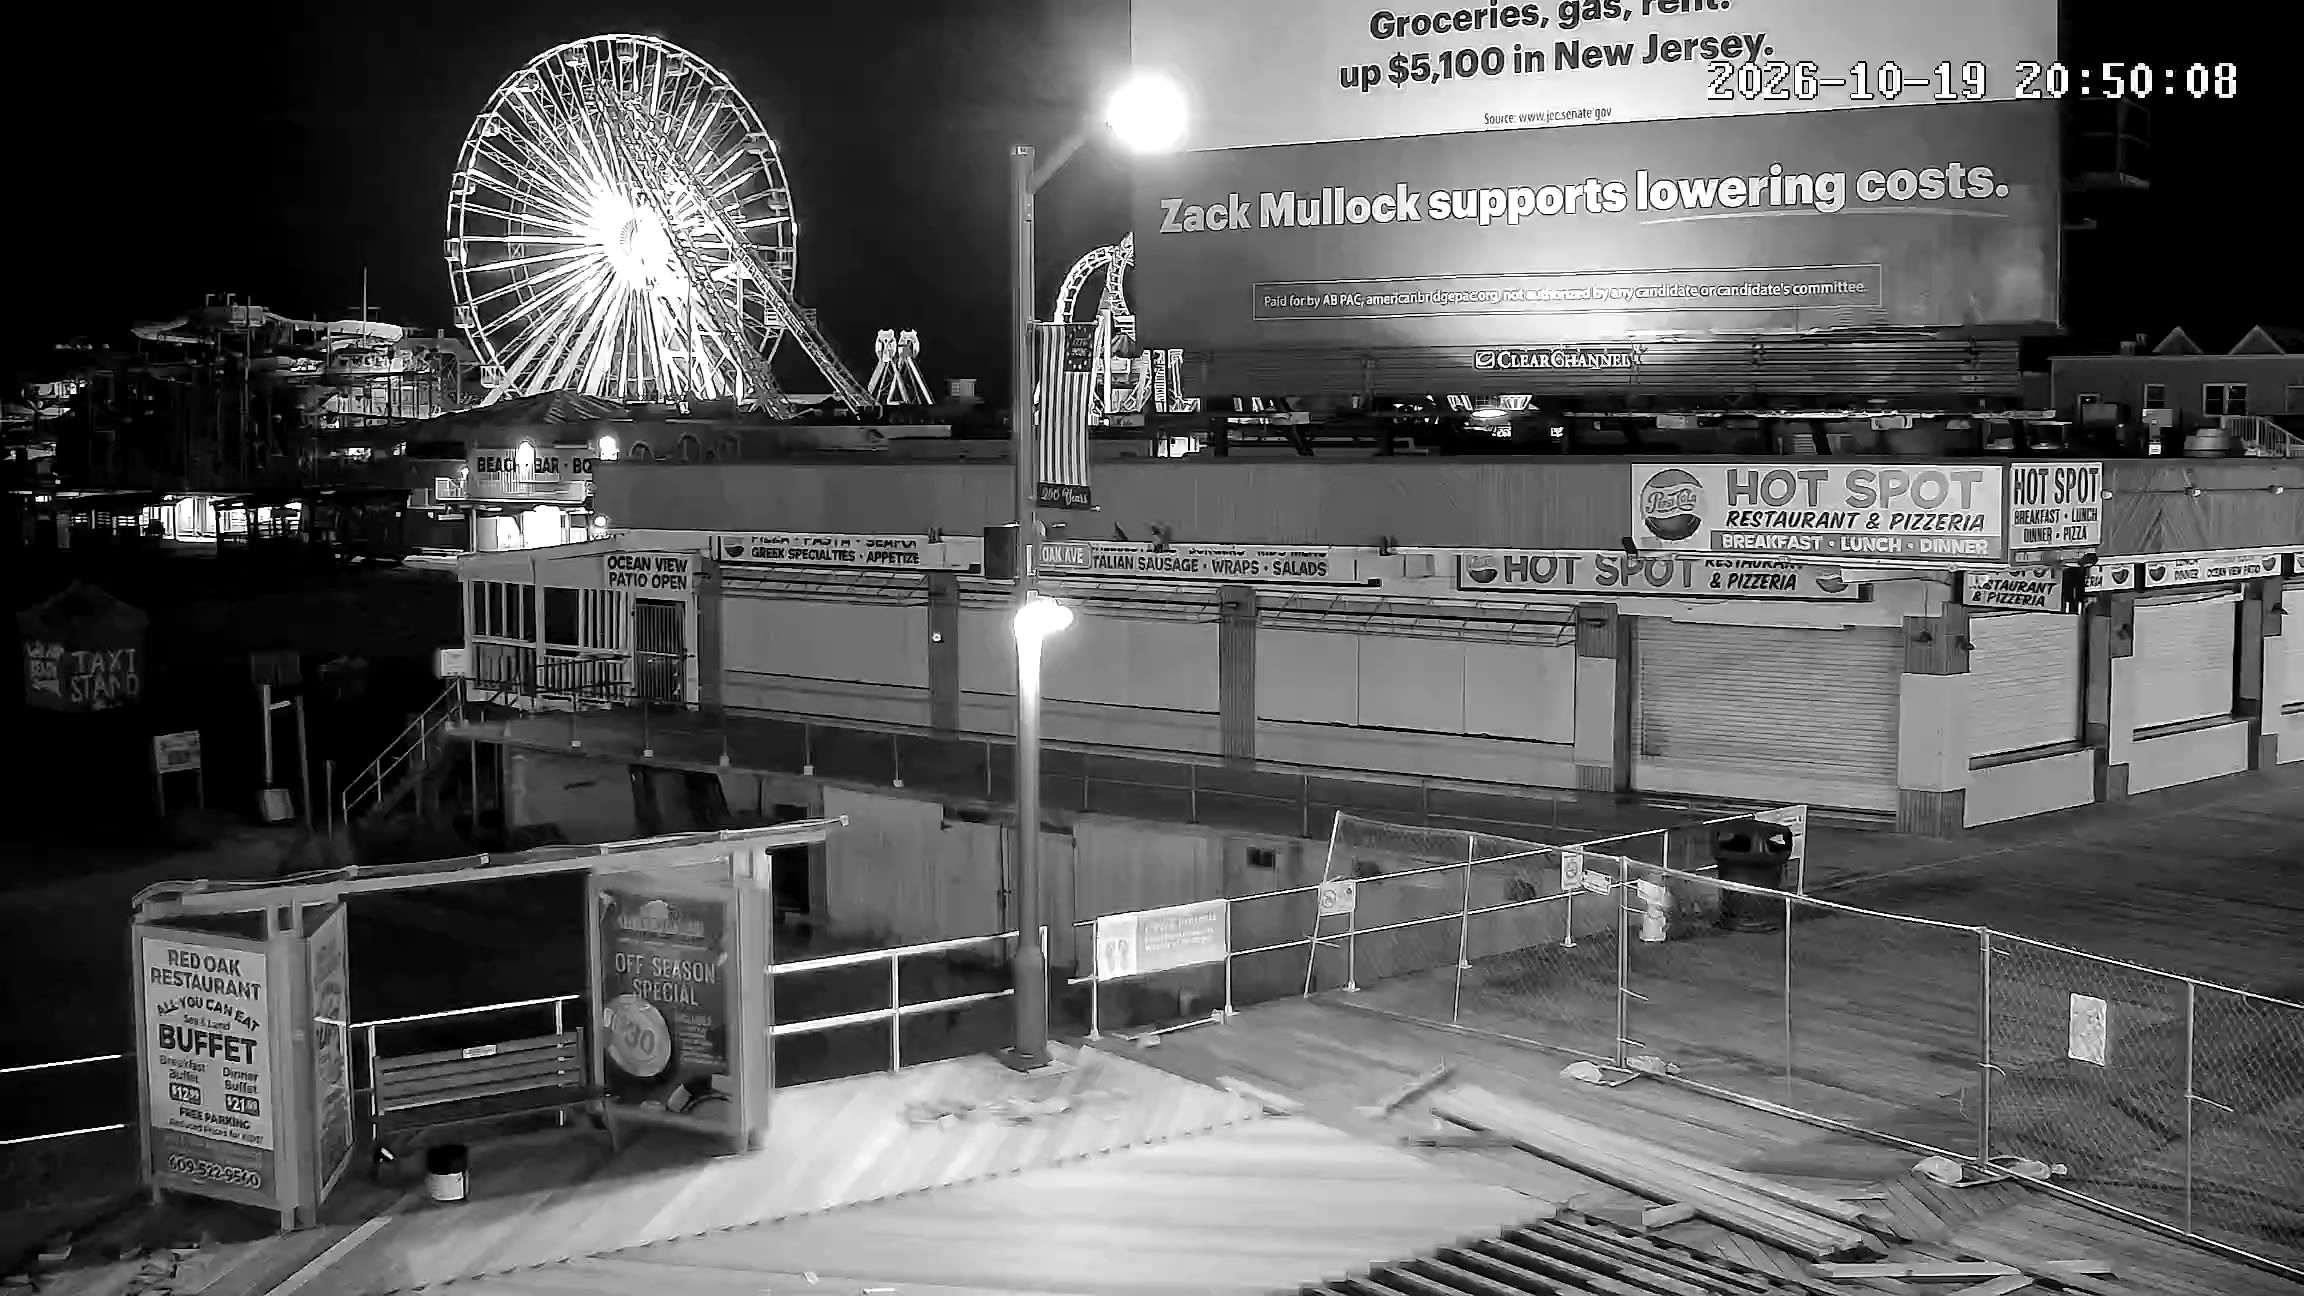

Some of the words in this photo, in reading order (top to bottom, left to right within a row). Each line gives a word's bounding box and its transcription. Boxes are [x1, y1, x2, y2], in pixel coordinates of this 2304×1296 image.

[1370, 0, 1548, 39] Groceries,
[1558, 0, 1632, 30] gas,
[1340, 64, 1382, 92] up
[1388, 45, 1505, 89] $5,100
[1513, 43, 1546, 74] in
[1554, 40, 1634, 71] New
[1642, 33, 1774, 63] Jersey.
[1160, 192, 1253, 233] Zack
[1260, 183, 1424, 228] Mullock
[1428, 178, 1628, 226] supports
[1635, 162, 1846, 213] lowering
[1855, 162, 2010, 202] costs.
[1264, 295, 1287, 307] Paid
[1289, 294, 1306, 307] for
[1307, 295, 1321, 309] by
[1323, 293, 1338, 306] AB
[1339, 293, 1364, 308] PAC,
[1593, 287, 1608, 301] by
[1610, 287, 1634, 301] any
[1635, 284, 1698, 299] candidate
[1700, 286, 1715, 297] or
[1716, 282, 1790, 298] candidate's
[1792, 280, 1869, 296] committee.
[535, 457, 560, 474] BAR
[1726, 468, 1829, 508] HOT
[1845, 468, 1983, 510] SPOT
[2014, 468, 2049, 506] HOT
[2054, 467, 2099, 504] SPOT
[1725, 510, 1859, 530] RESTAURANT
[1866, 512, 1880, 530] &
[1889, 512, 1986, 533] PIZZERIA
[2014, 508, 2060, 525] BREAKFAST
[2071, 506, 2098, 523] LUNCH
[1722, 533, 1824, 551] BREAKFAST
[1841, 534, 1902, 553] LUNCH
[1920, 536, 1989, 555] DINNER
[2063, 525, 2087, 541] PIZZA
[607, 555, 651, 571] OCEAN
[653, 557, 688, 573] VIEW
[751, 547, 785, 560] GREEK
[787, 549, 856, 562] SPECIALTIES
[1042, 546, 1062, 562] OAK
[1064, 546, 1084, 564] AVE
[1138, 557, 1200, 574] SAUSAGE
[1211, 559, 1260, 576] WRAPS
[1272, 560, 1328, 578] SALADS
[1503, 555, 1582, 585] HOT
[1595, 553, 1693, 588] SPOT
[608, 572, 648, 589] PATIO
[651, 573, 688, 590] OPEN
[1709, 572, 1721, 589] &
[1727, 572, 1798, 591] PIZZERIA
[1986, 591, 2045, 607] PIZZERIA
[71, 648, 136, 673] TAXI
[71, 673, 140, 703] STAND
[168, 949, 200, 969] RED
[204, 956, 241, 977] OAK
[616, 952, 645, 974] OFF
[652, 956, 716, 984] SEASON
[151, 967, 261, 1000] RESTAURANT
[631, 978, 698, 1006] SPECIAL
[157, 999, 179, 1016] ALL
[180, 996, 203, 1008] YOU
[206, 999, 233, 1016] CAN
[234, 1010, 260, 1032] EAT
[160, 1023, 258, 1064] BUFFET
[223, 1066, 259, 1083] Dinner
[204, 1111, 251, 1130] PARKING
